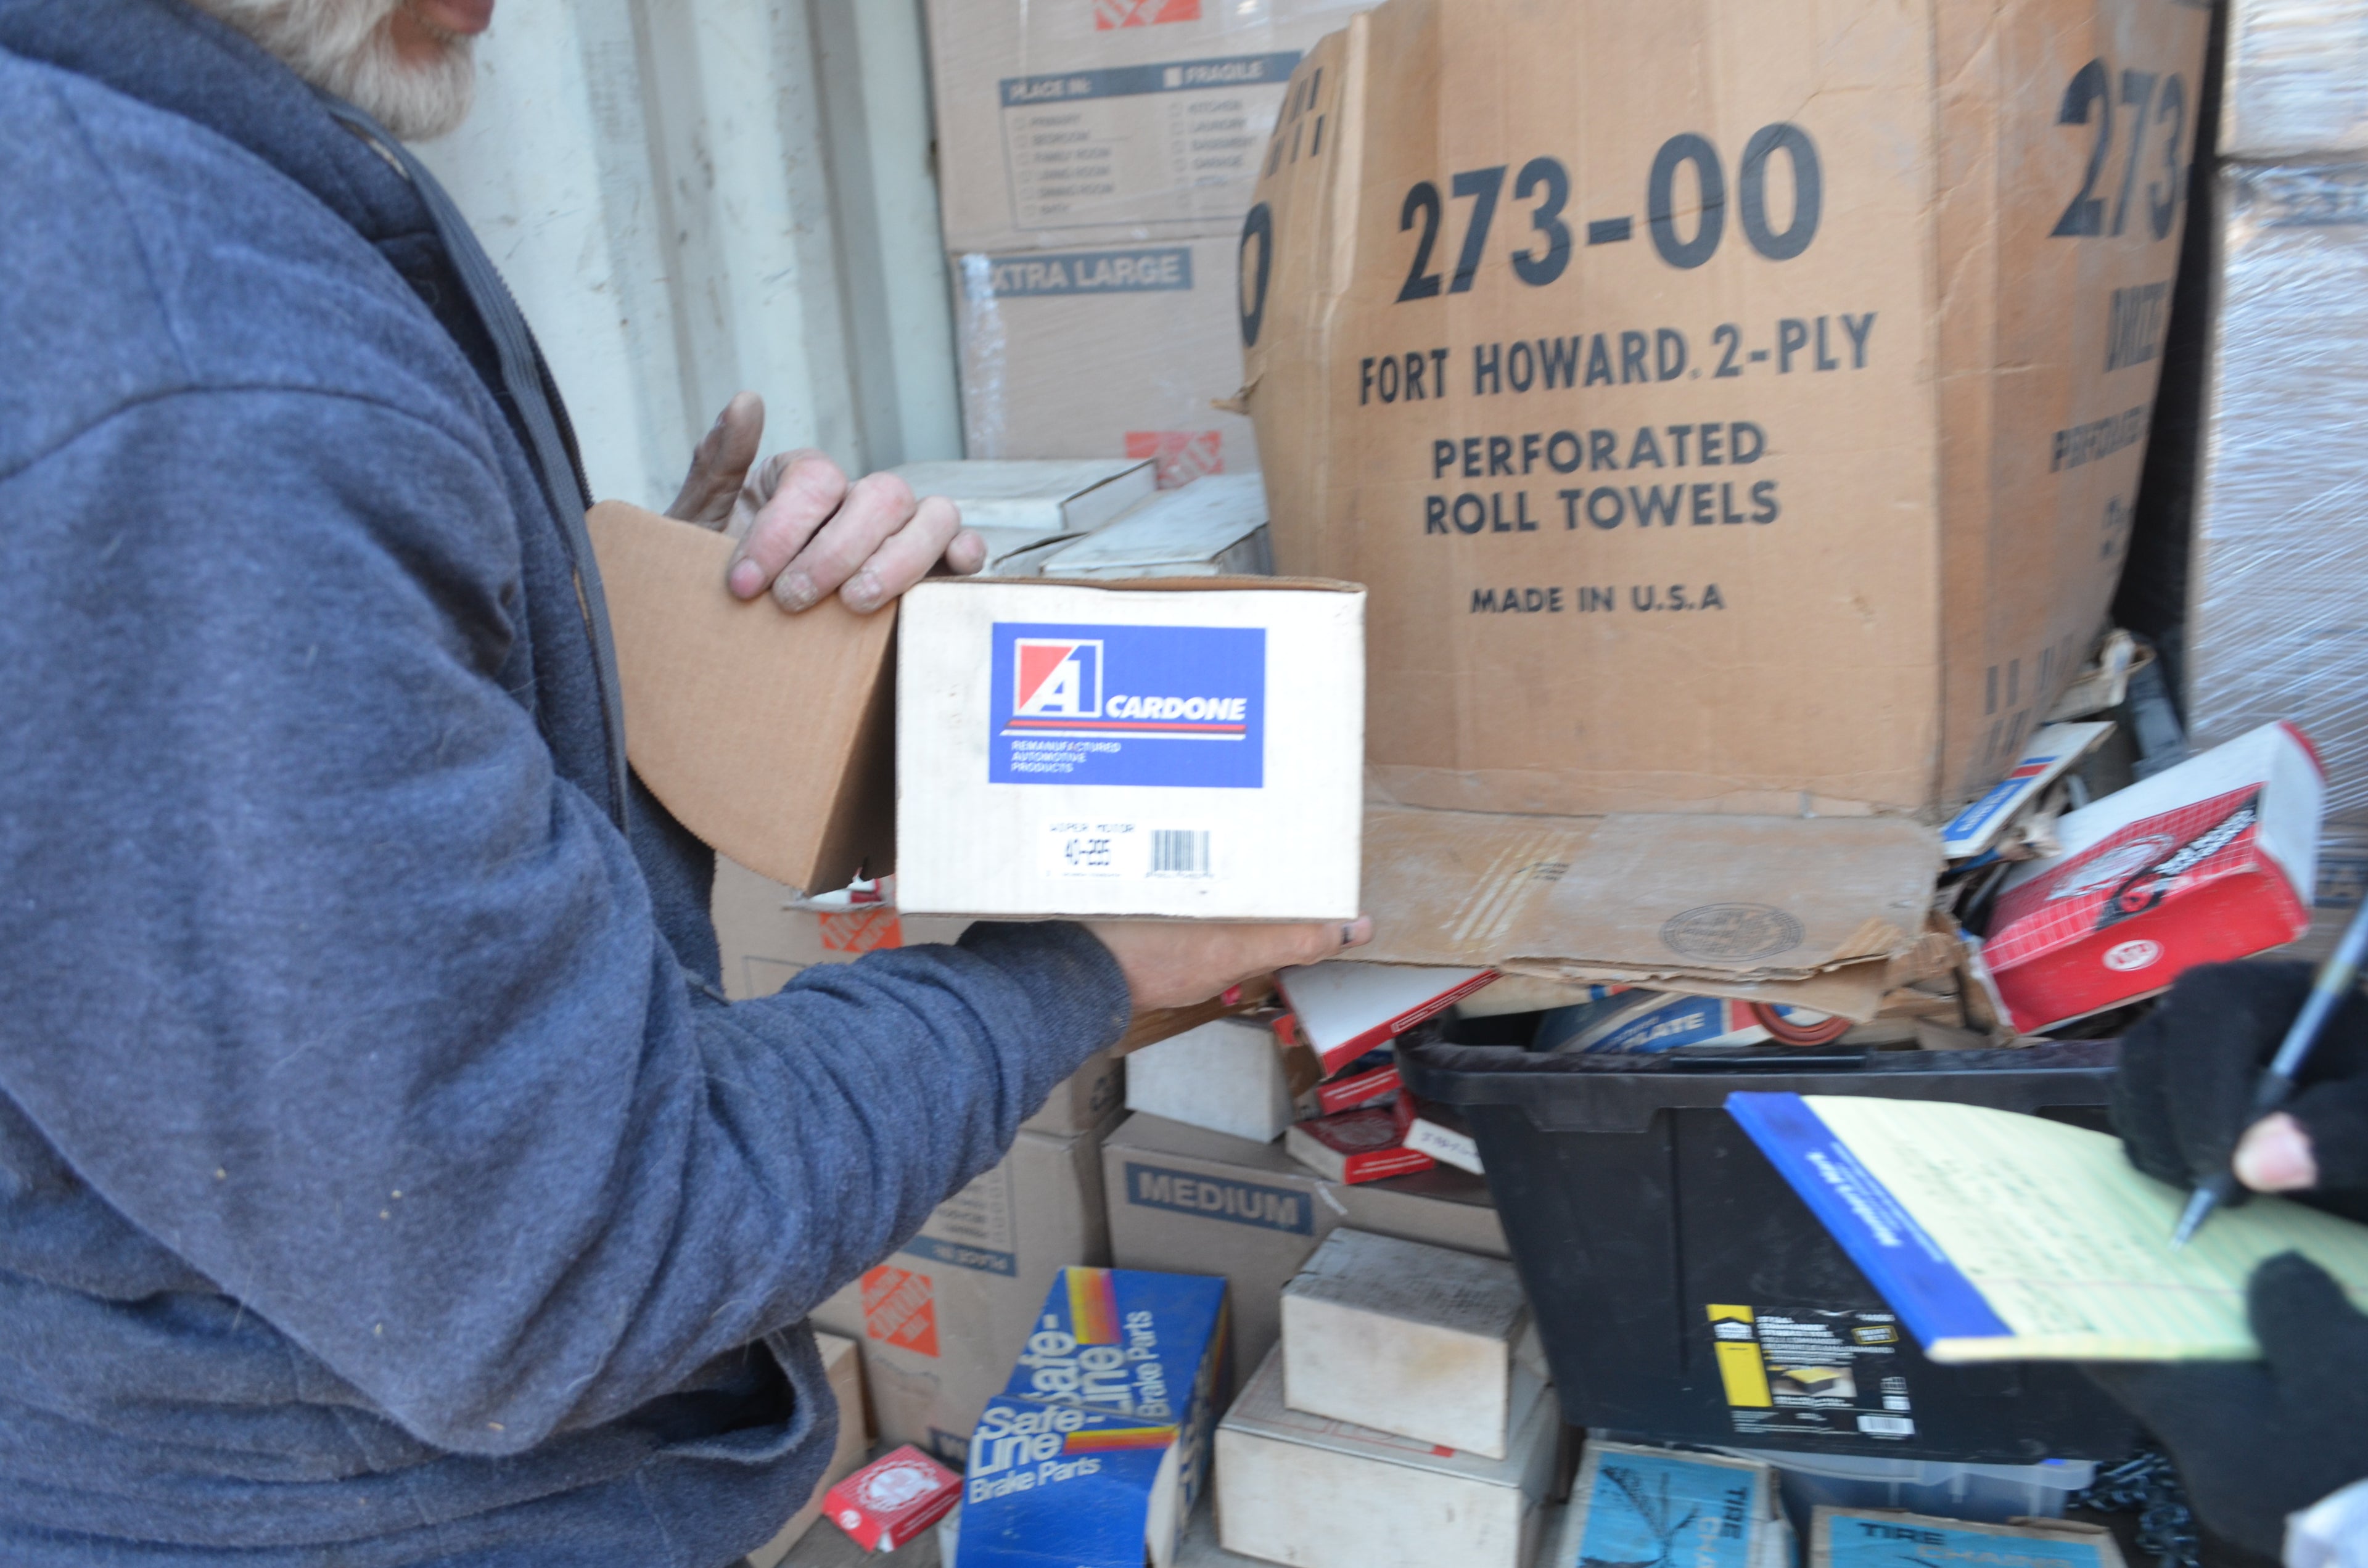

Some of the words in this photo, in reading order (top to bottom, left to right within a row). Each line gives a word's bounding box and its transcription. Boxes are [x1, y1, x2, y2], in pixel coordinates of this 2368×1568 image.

[1010, 79, 1066, 101] PLACE
[1186, 61, 1264, 83] FRAGILE
[1392, 121, 1823, 303] 273-00
[987, 262, 1069, 291] XTRA
[1074, 254, 1180, 288] LARGE
[1360, 348, 1448, 406] FORT
[1711, 312, 1878, 379] 2-PLY
[1432, 421, 1767, 478] PERFORATED
[1424, 492, 1538, 535] ROLL
[1560, 480, 1782, 532] TOWELS
[1471, 586, 1563, 614] MADE
[1579, 586, 1614, 612] IN
[1106, 695, 1247, 720] CARDONE
[1010, 762, 1074, 773] PRODUCTS
[1011, 741, 1121, 752] REMANUFACTURED
[1011, 752, 1087, 763] AUTOMOTIVE
[1138, 1172, 1299, 1225] MEDIUM
[1124, 1310, 1159, 1360] Parts
[1132, 1363, 1171, 1417] Brake
[982, 1405, 1106, 1440] Safe-
[969, 1426, 1063, 1479] Line
[969, 1470, 1037, 1504] Brake
[1038, 1456, 1103, 1486] Parts
[1720, 1487, 1747, 1539] TIRE
[1857, 1522, 1947, 1545] TIRE
